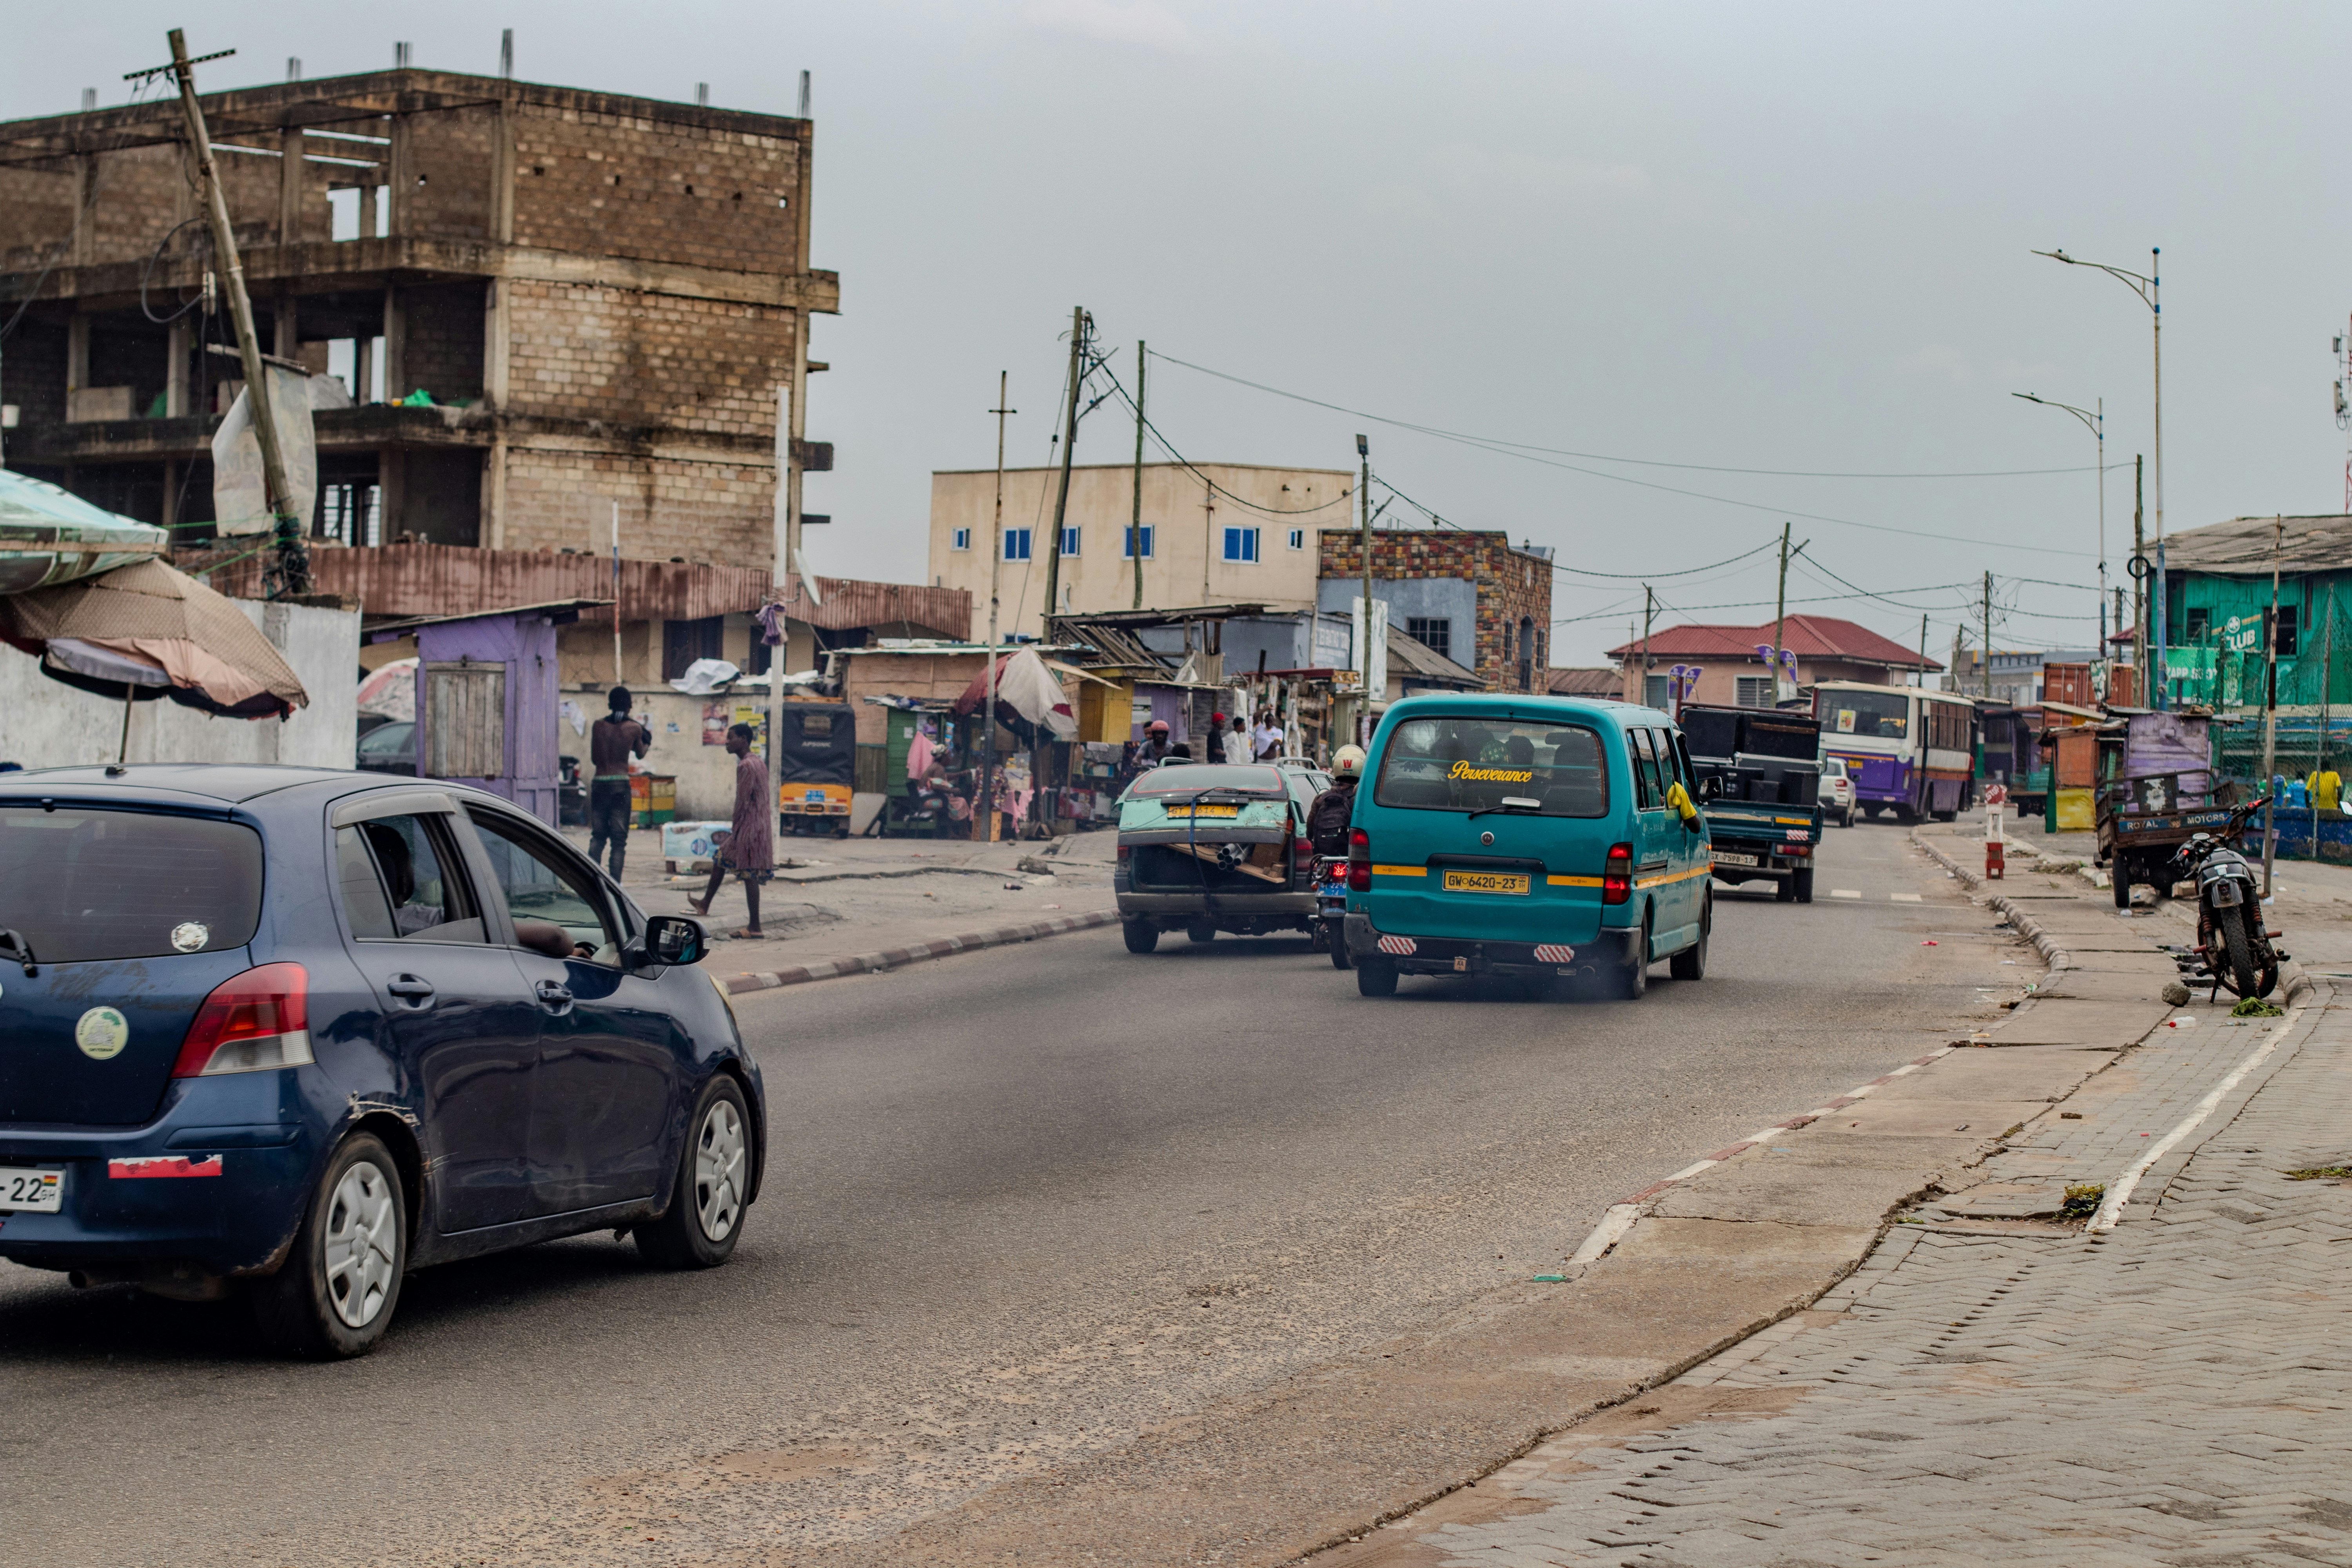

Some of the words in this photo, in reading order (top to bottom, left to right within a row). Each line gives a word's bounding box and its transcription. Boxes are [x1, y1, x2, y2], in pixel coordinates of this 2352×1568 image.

[1448, 760, 1532, 782] Perseverance
[1985, 785, 2000, 801] STOP
[2187, 813, 2225, 824] MOTORS
[1448, 875, 1462, 886] GW
[1469, 876, 1517, 889] 6420-23
